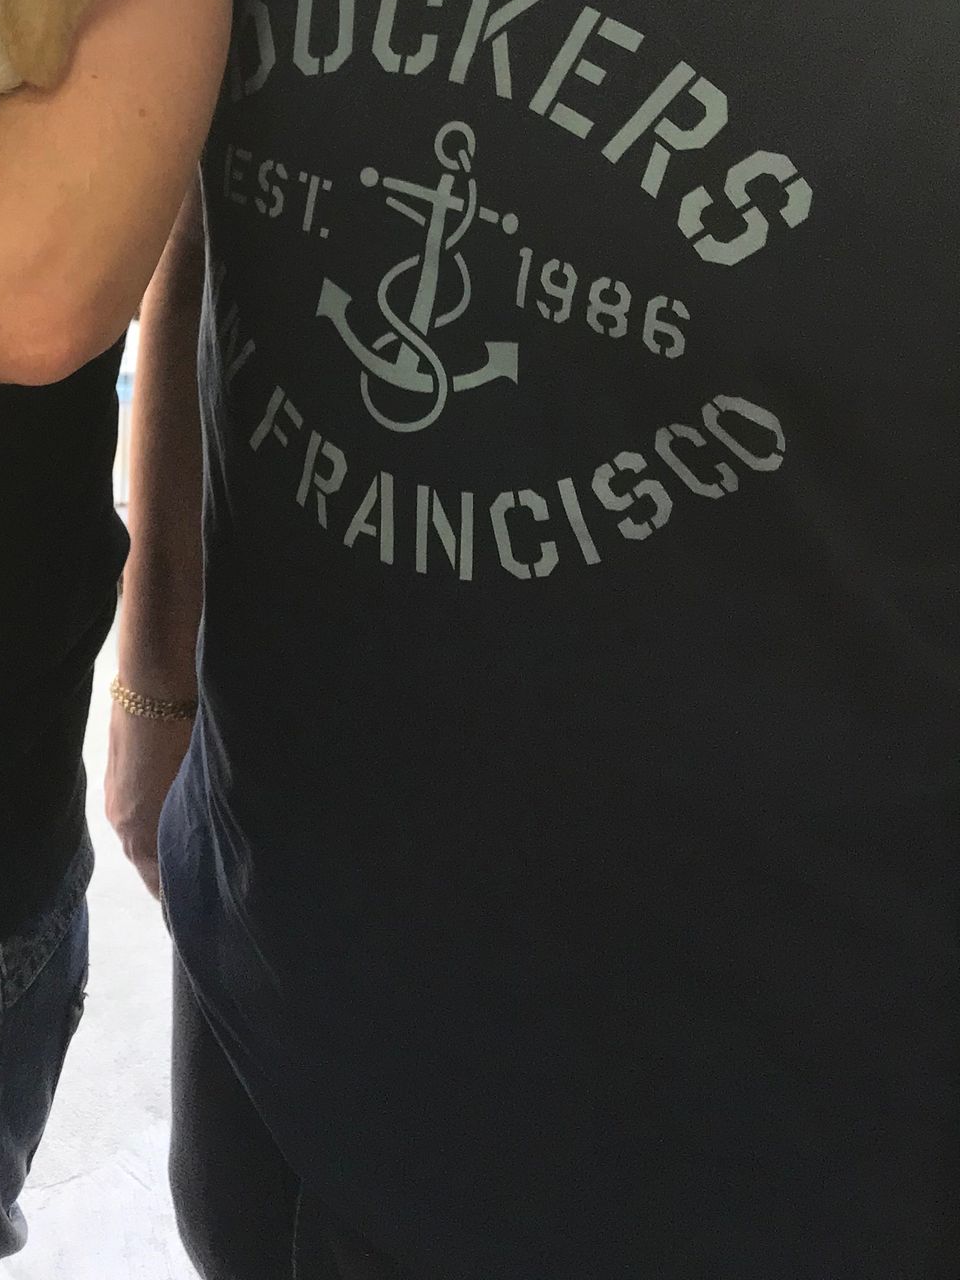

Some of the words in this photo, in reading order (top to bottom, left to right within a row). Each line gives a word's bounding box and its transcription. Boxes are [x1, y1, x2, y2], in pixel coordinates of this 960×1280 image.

[223, 143, 333, 239] EST.
[515, 246, 691, 360] 1986
[247, 384, 787, 581] FRANCISCO
